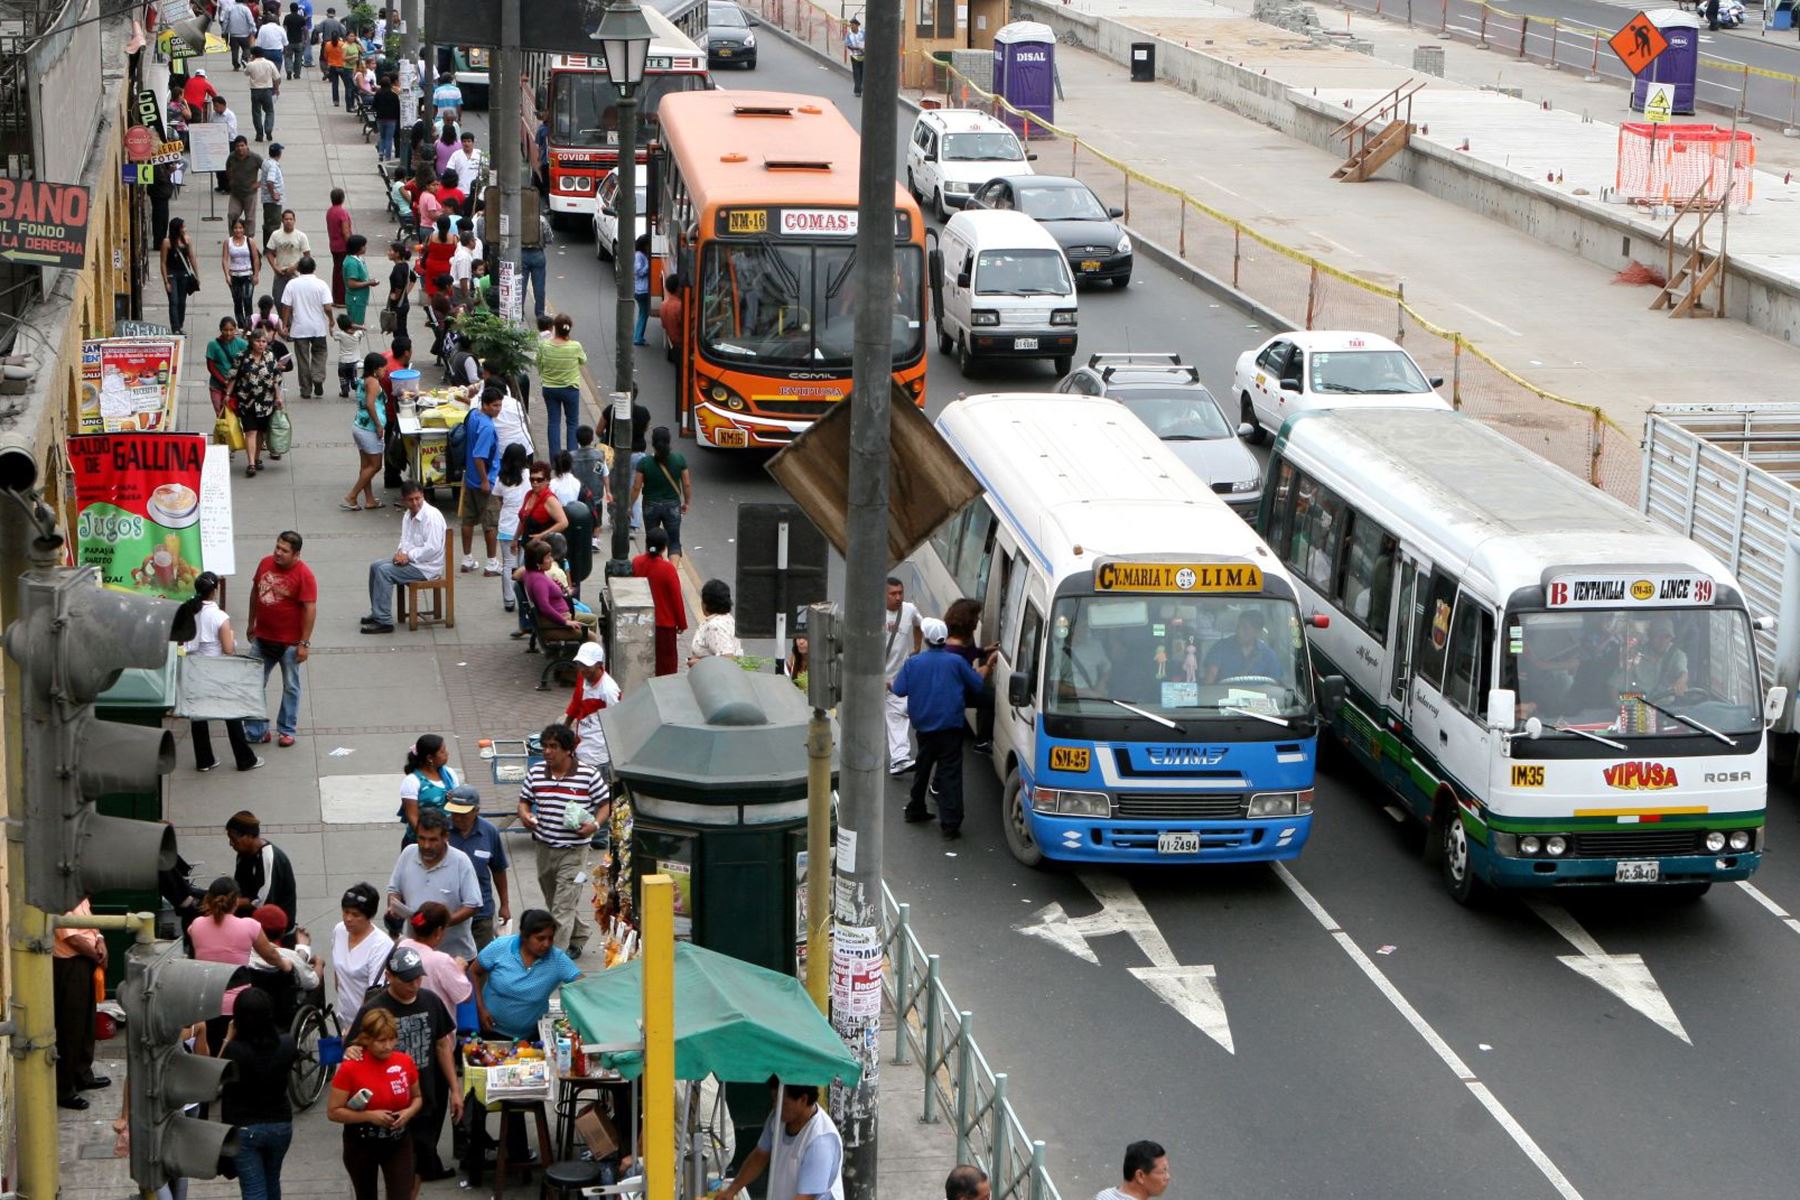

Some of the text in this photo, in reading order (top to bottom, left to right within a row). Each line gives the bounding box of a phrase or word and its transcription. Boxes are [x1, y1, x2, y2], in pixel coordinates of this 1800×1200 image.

[1016, 52, 1046, 62] DISAL
[557, 153, 590, 161] COVIDA
[731, 213, 767, 230] NM-16
[18, 223, 65, 238] FONDO
[1, 235, 84, 256] LA DERECHA
[1348, 340, 1365, 348] TAXI
[113, 441, 202, 472] GALLINA
[85, 457, 101, 473] DE
[79, 512, 143, 543] Jugos
[1201, 569, 1258, 586] LIMA
[1550, 583, 1568, 605] B
[1574, 581, 1625, 600] VENTANILLA
[1659, 579, 1691, 599] LINCE
[1694, 580, 1713, 602] 39
[1602, 761, 1679, 788] VIPUSA
[1704, 771, 1751, 783] ROSA
[1159, 840, 1197, 851] VI-2494
